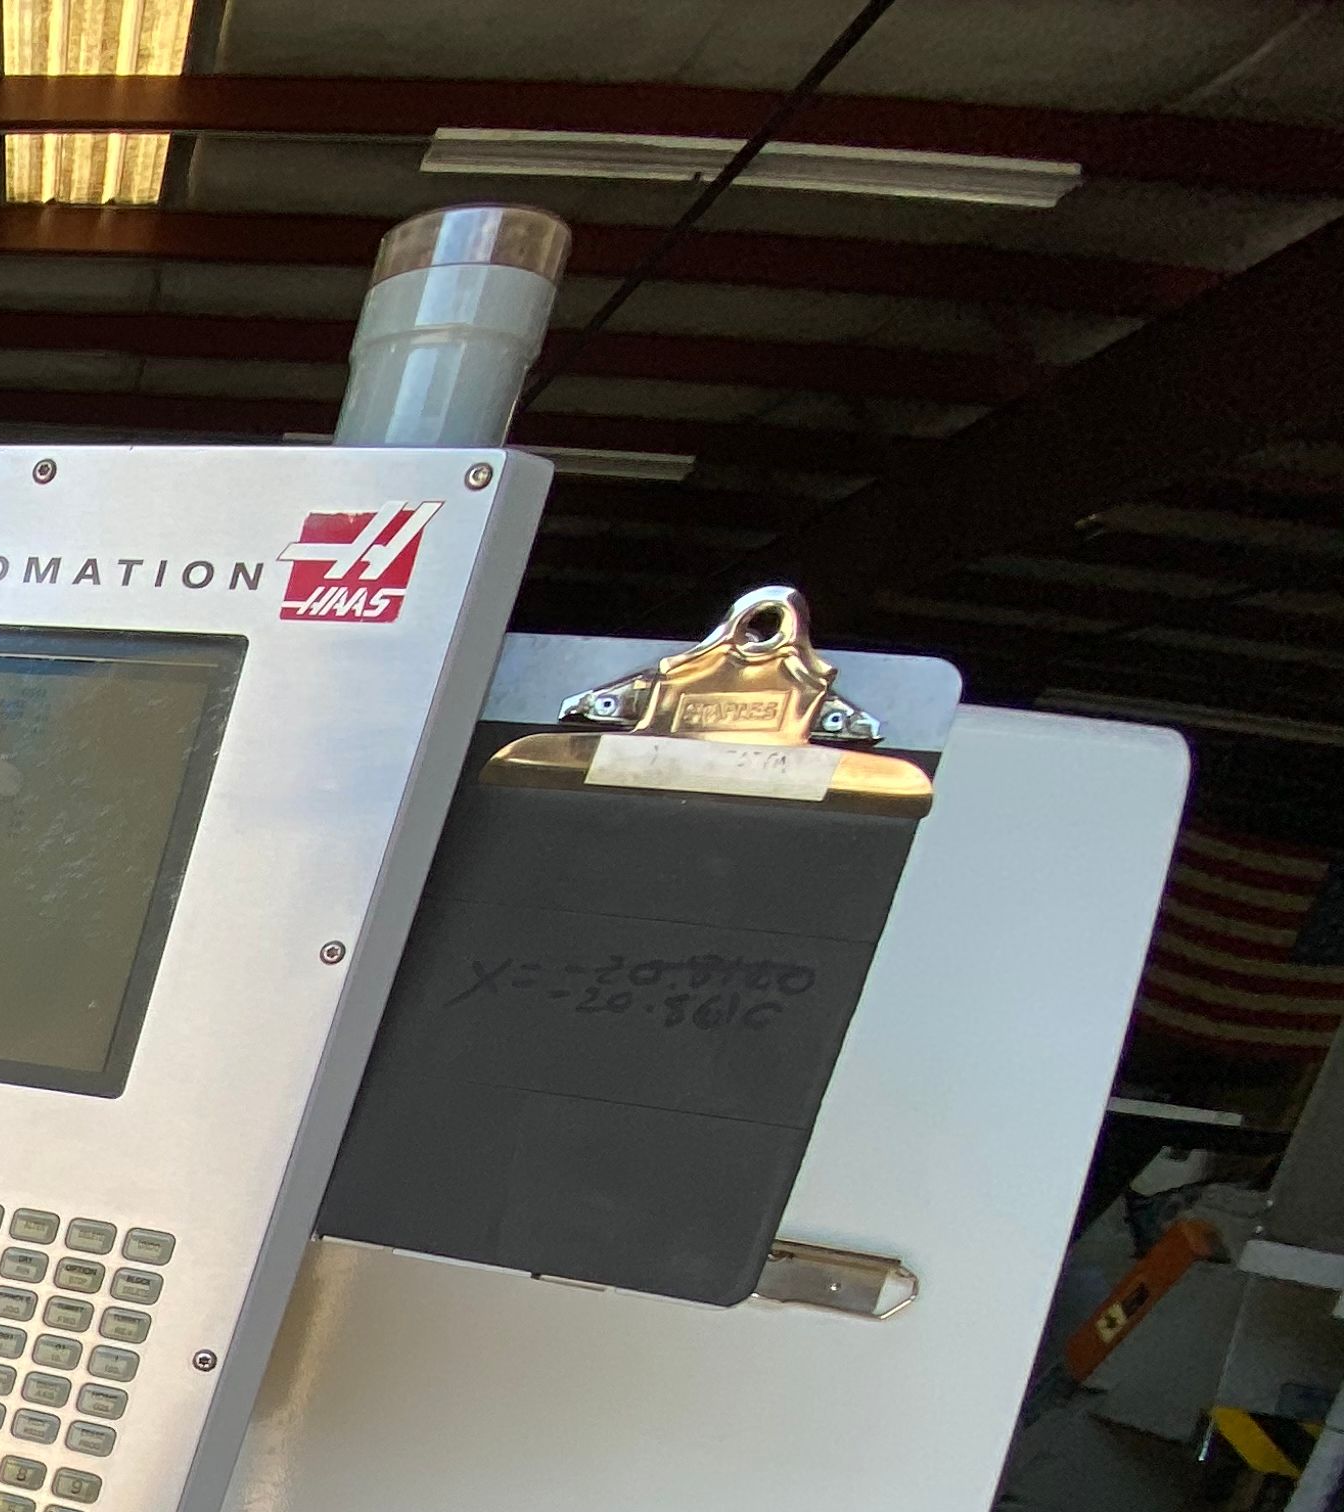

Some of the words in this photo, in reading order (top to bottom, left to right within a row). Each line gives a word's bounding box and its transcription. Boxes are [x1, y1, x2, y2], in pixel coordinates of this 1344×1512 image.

[282, 587, 407, 616] HAAS
[16, 1468, 26, 1481] 8
[71, 1481, 82, 1495] 9
